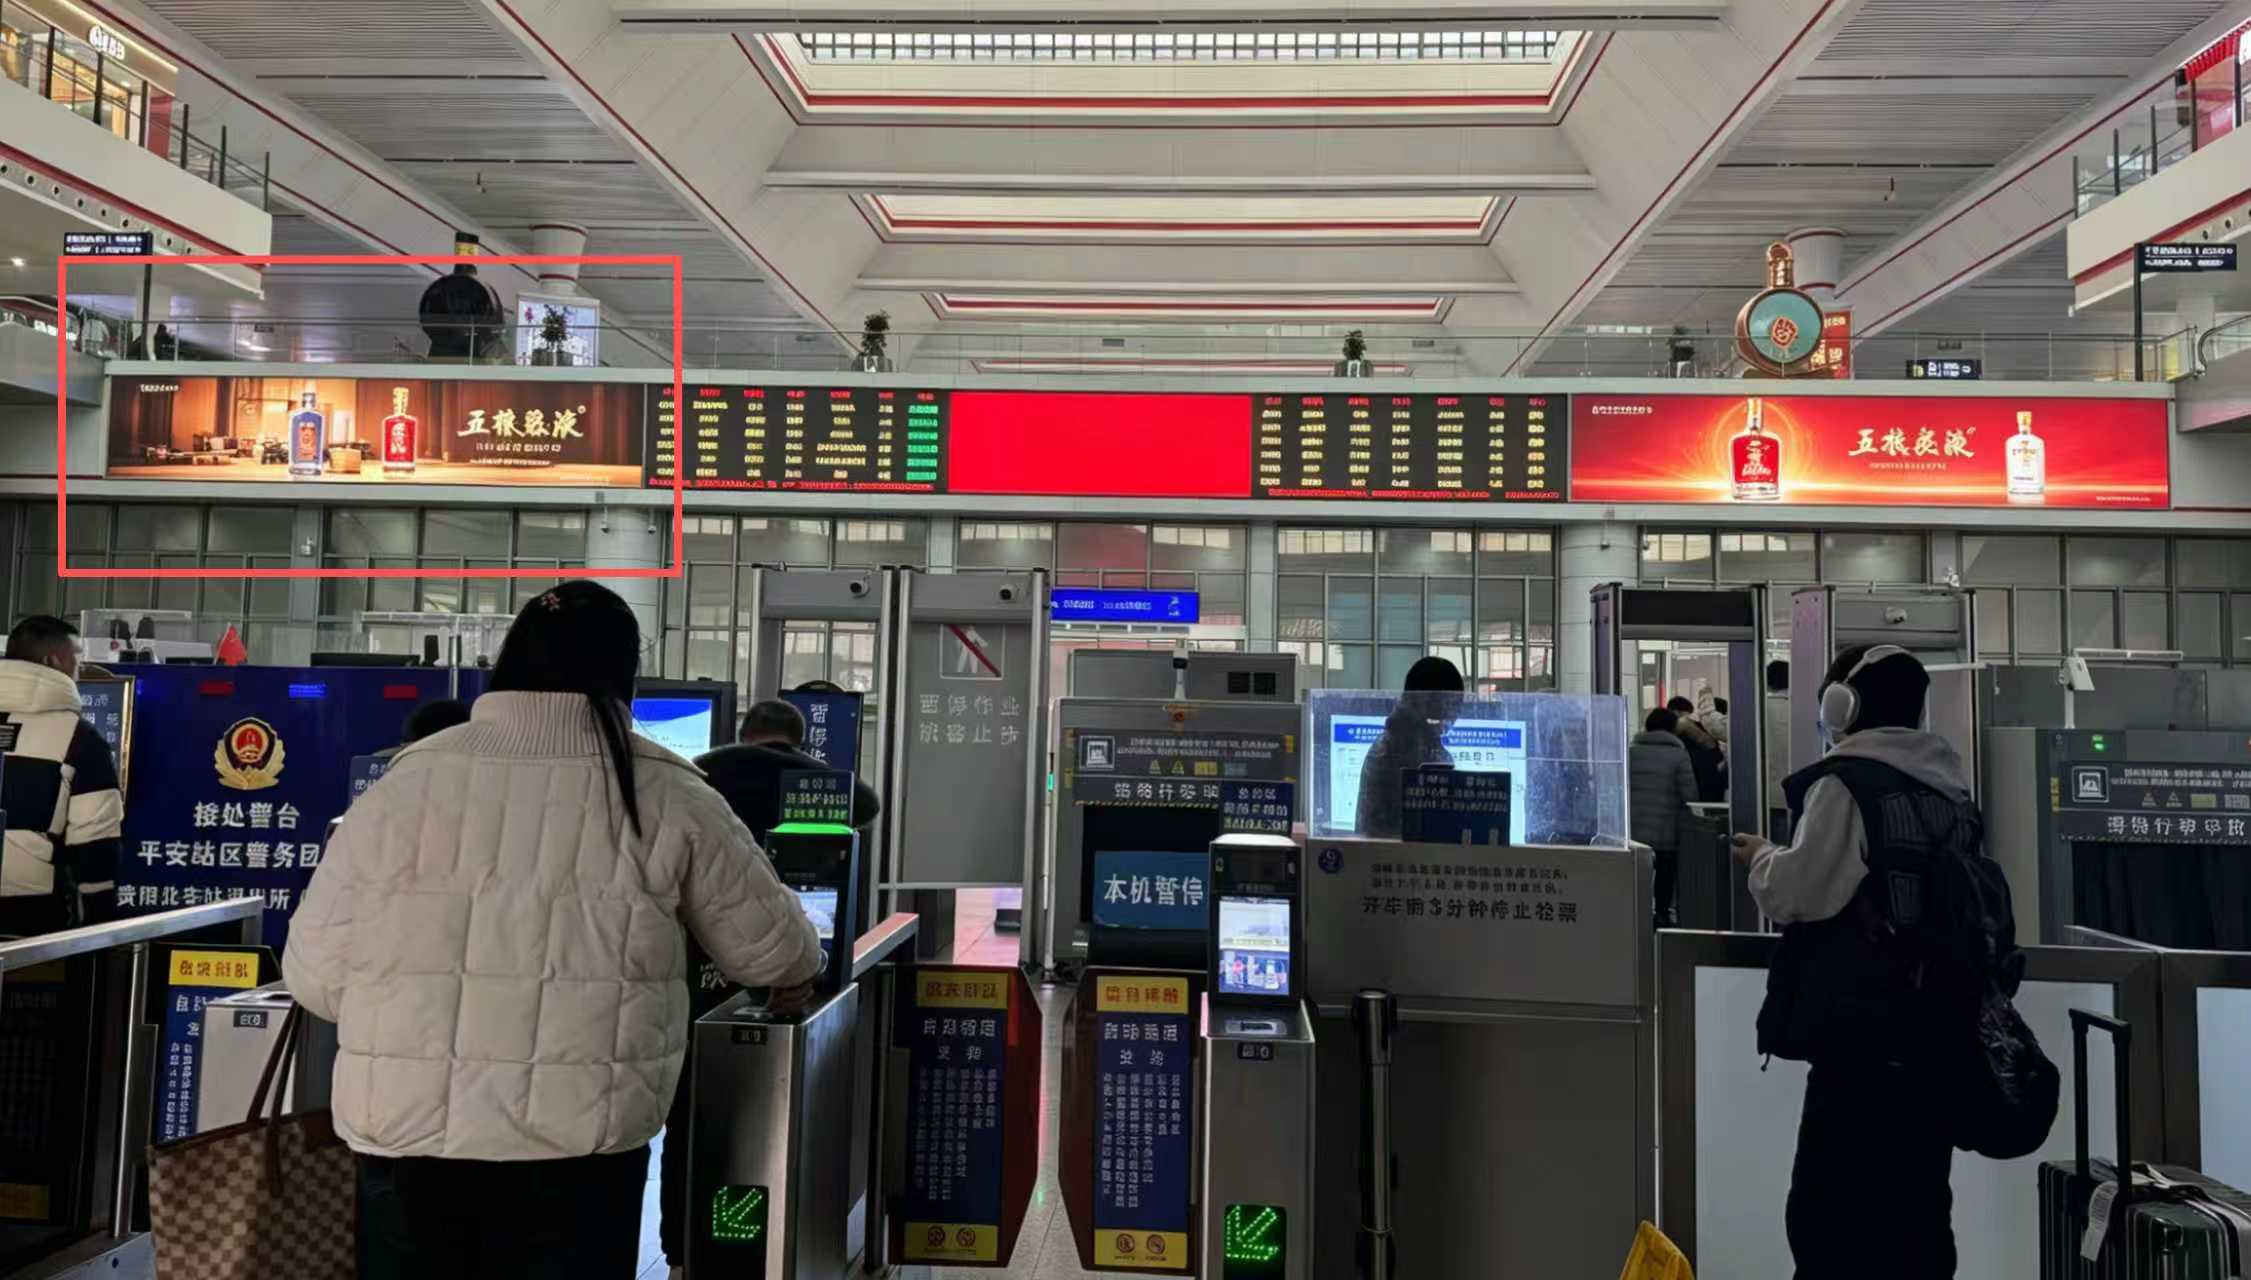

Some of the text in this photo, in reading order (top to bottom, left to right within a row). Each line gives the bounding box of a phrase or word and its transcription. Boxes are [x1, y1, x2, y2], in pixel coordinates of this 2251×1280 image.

[193, 801, 300, 830] 接处警台
[137, 840, 321, 869] 平安站区警务团
[1104, 873, 1204, 906] 本机暂停
